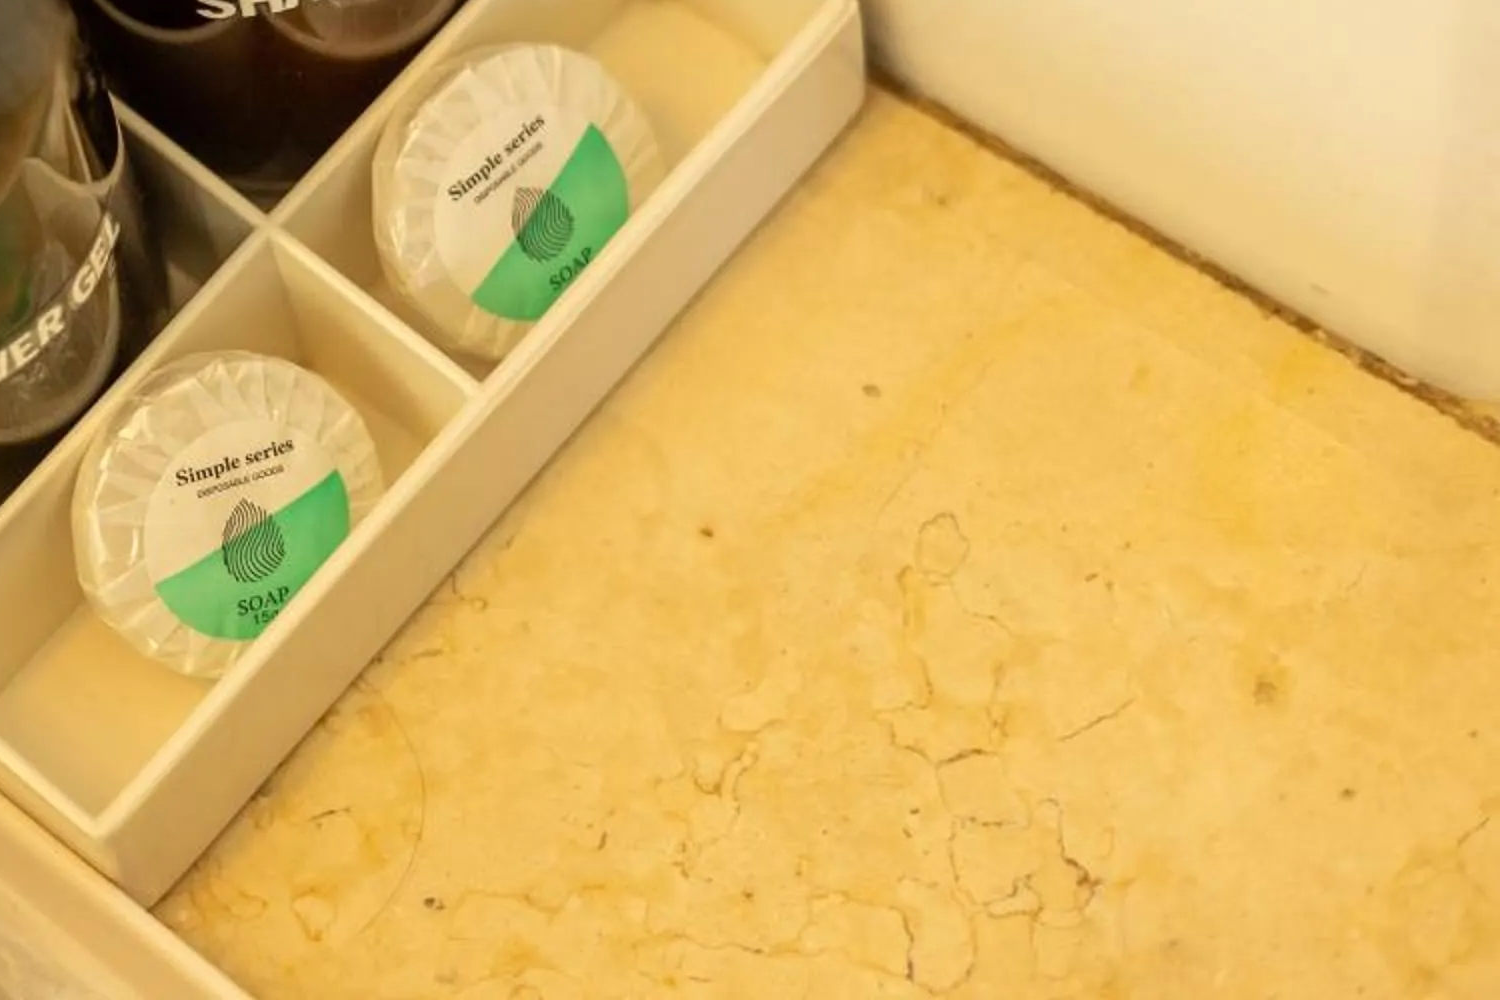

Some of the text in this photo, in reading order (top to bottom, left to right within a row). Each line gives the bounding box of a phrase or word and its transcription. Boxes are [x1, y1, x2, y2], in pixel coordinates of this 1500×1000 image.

[447, 153, 502, 201] Simple
[504, 115, 545, 155] series
[71, 212, 121, 310] GEL
[549, 247, 592, 291] SOAP
[175, 440, 295, 487] Simple series
[237, 586, 289, 616] SOAP
